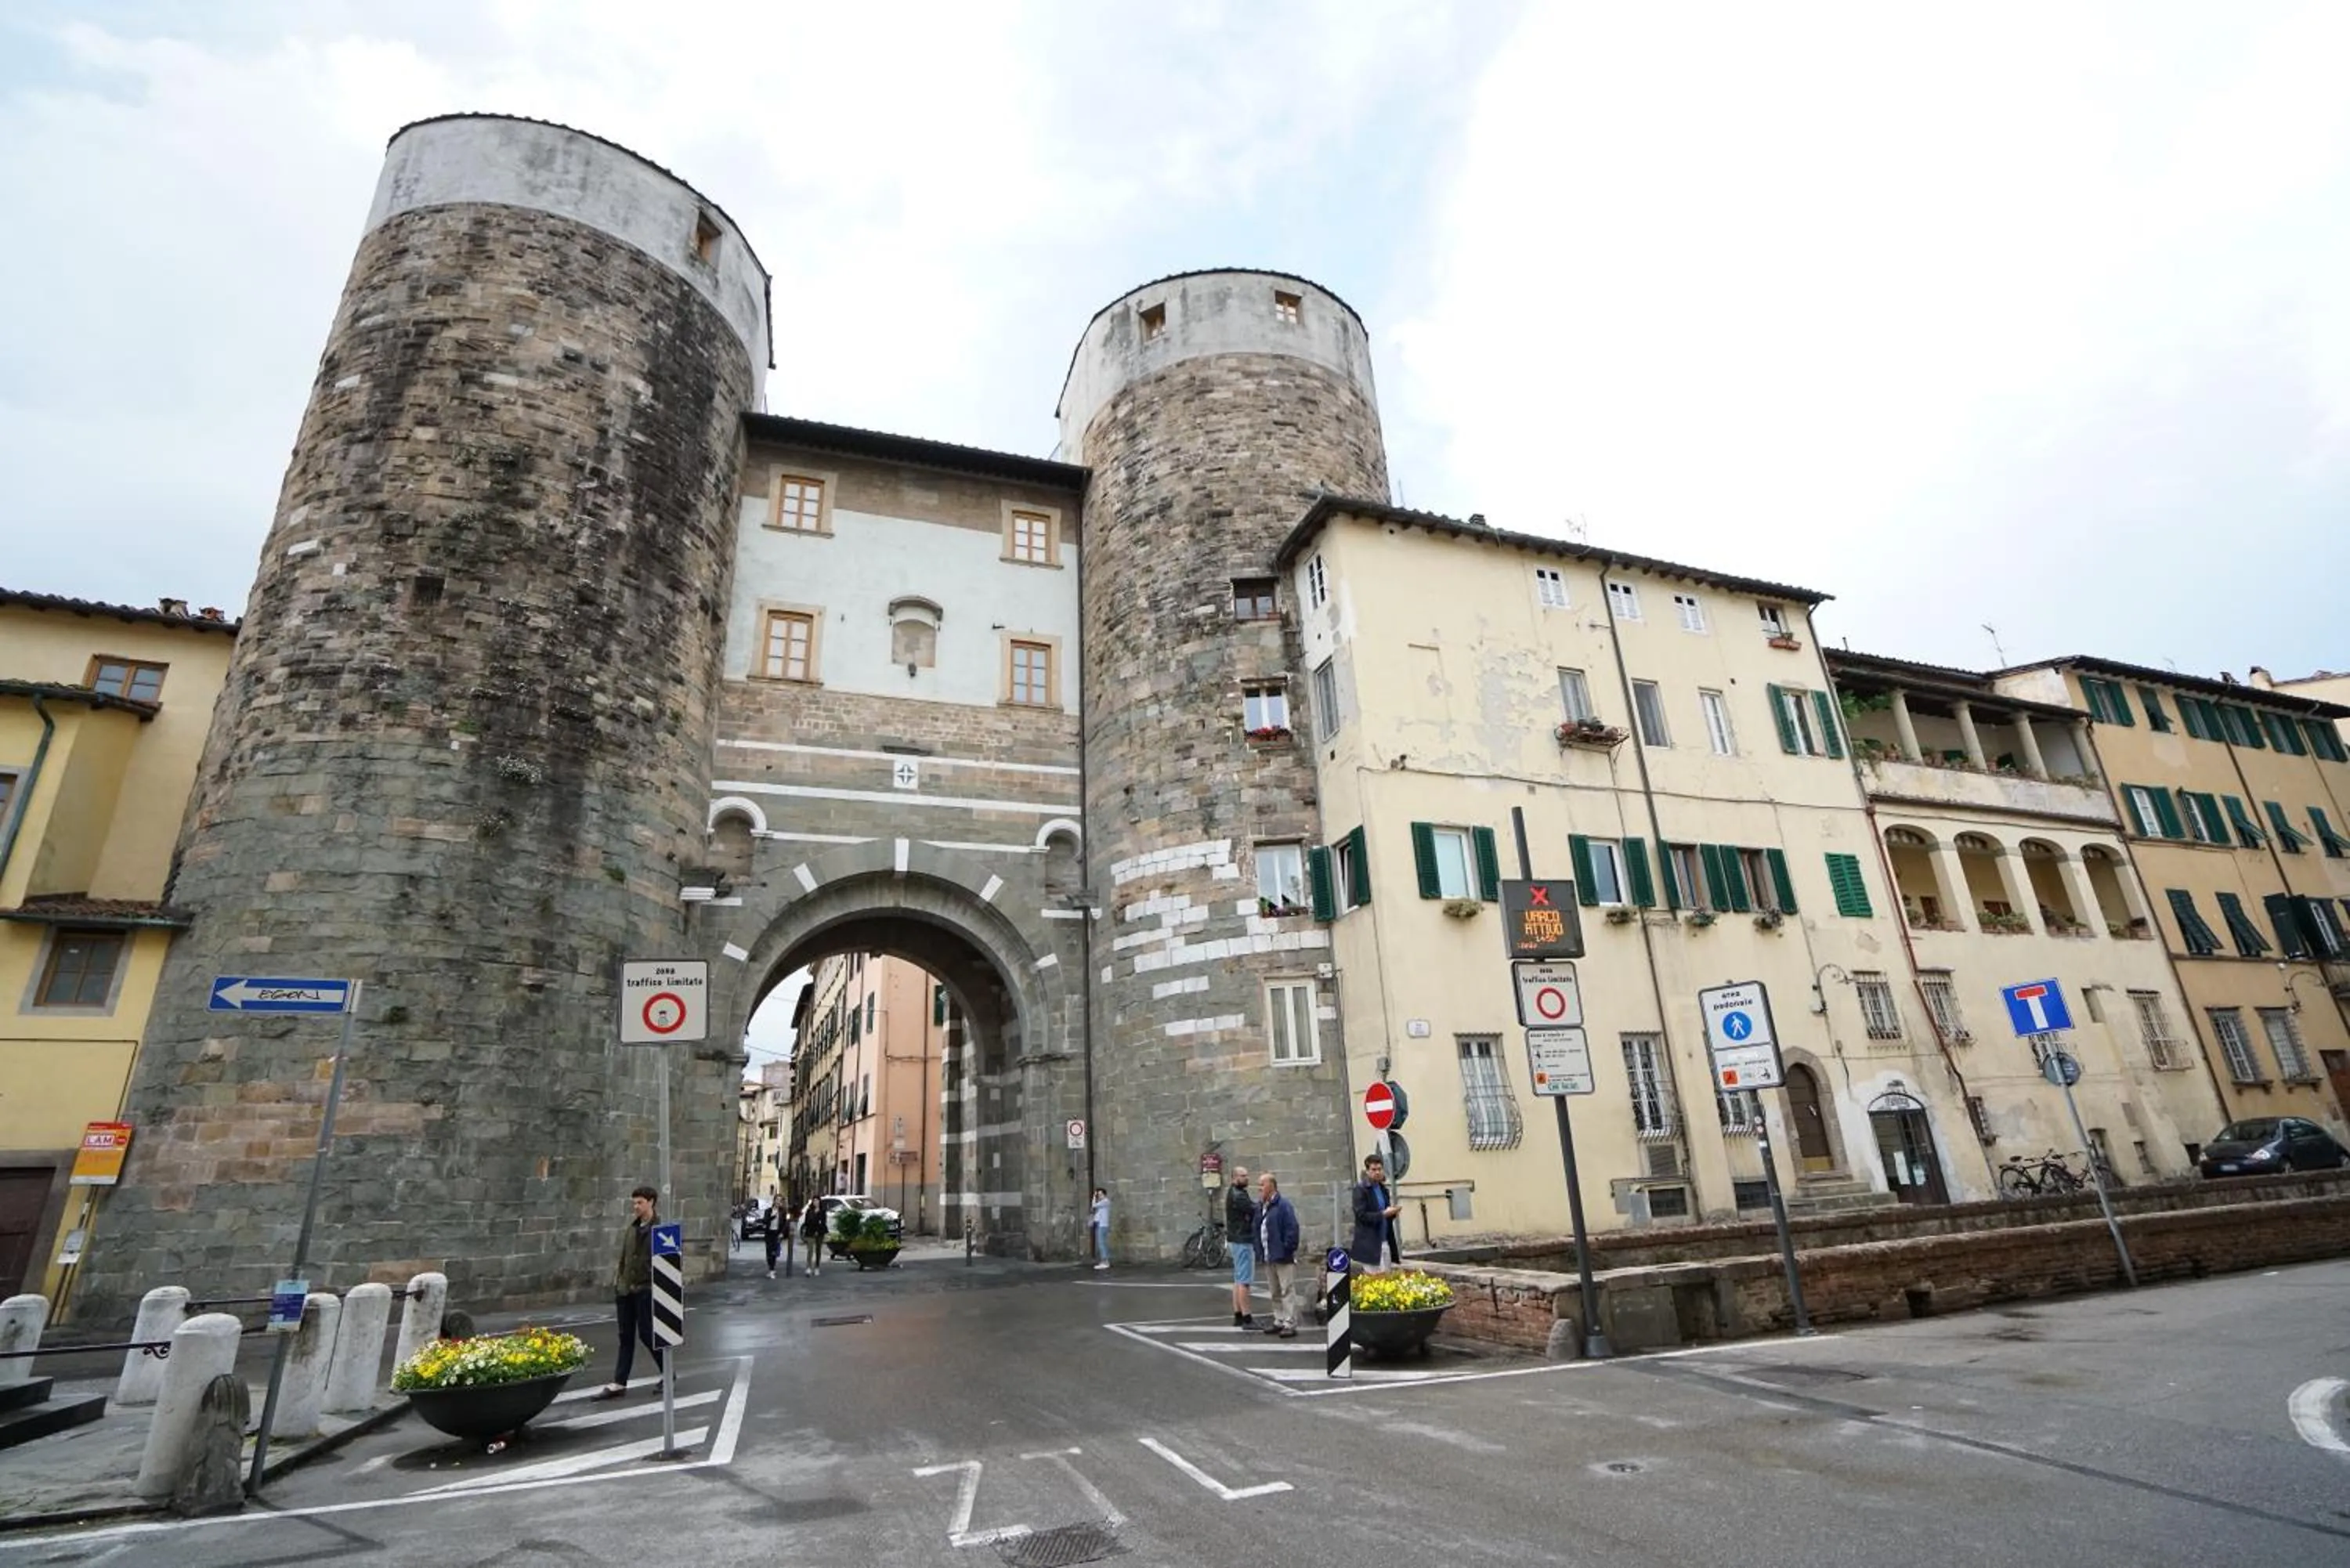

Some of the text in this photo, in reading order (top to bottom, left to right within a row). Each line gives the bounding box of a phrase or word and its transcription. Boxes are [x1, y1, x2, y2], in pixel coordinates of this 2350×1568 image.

[1524, 910, 1560, 923] VARCO
[1524, 923, 1564, 935] ATTIVO
[627, 977, 703, 987] traffico limitato
